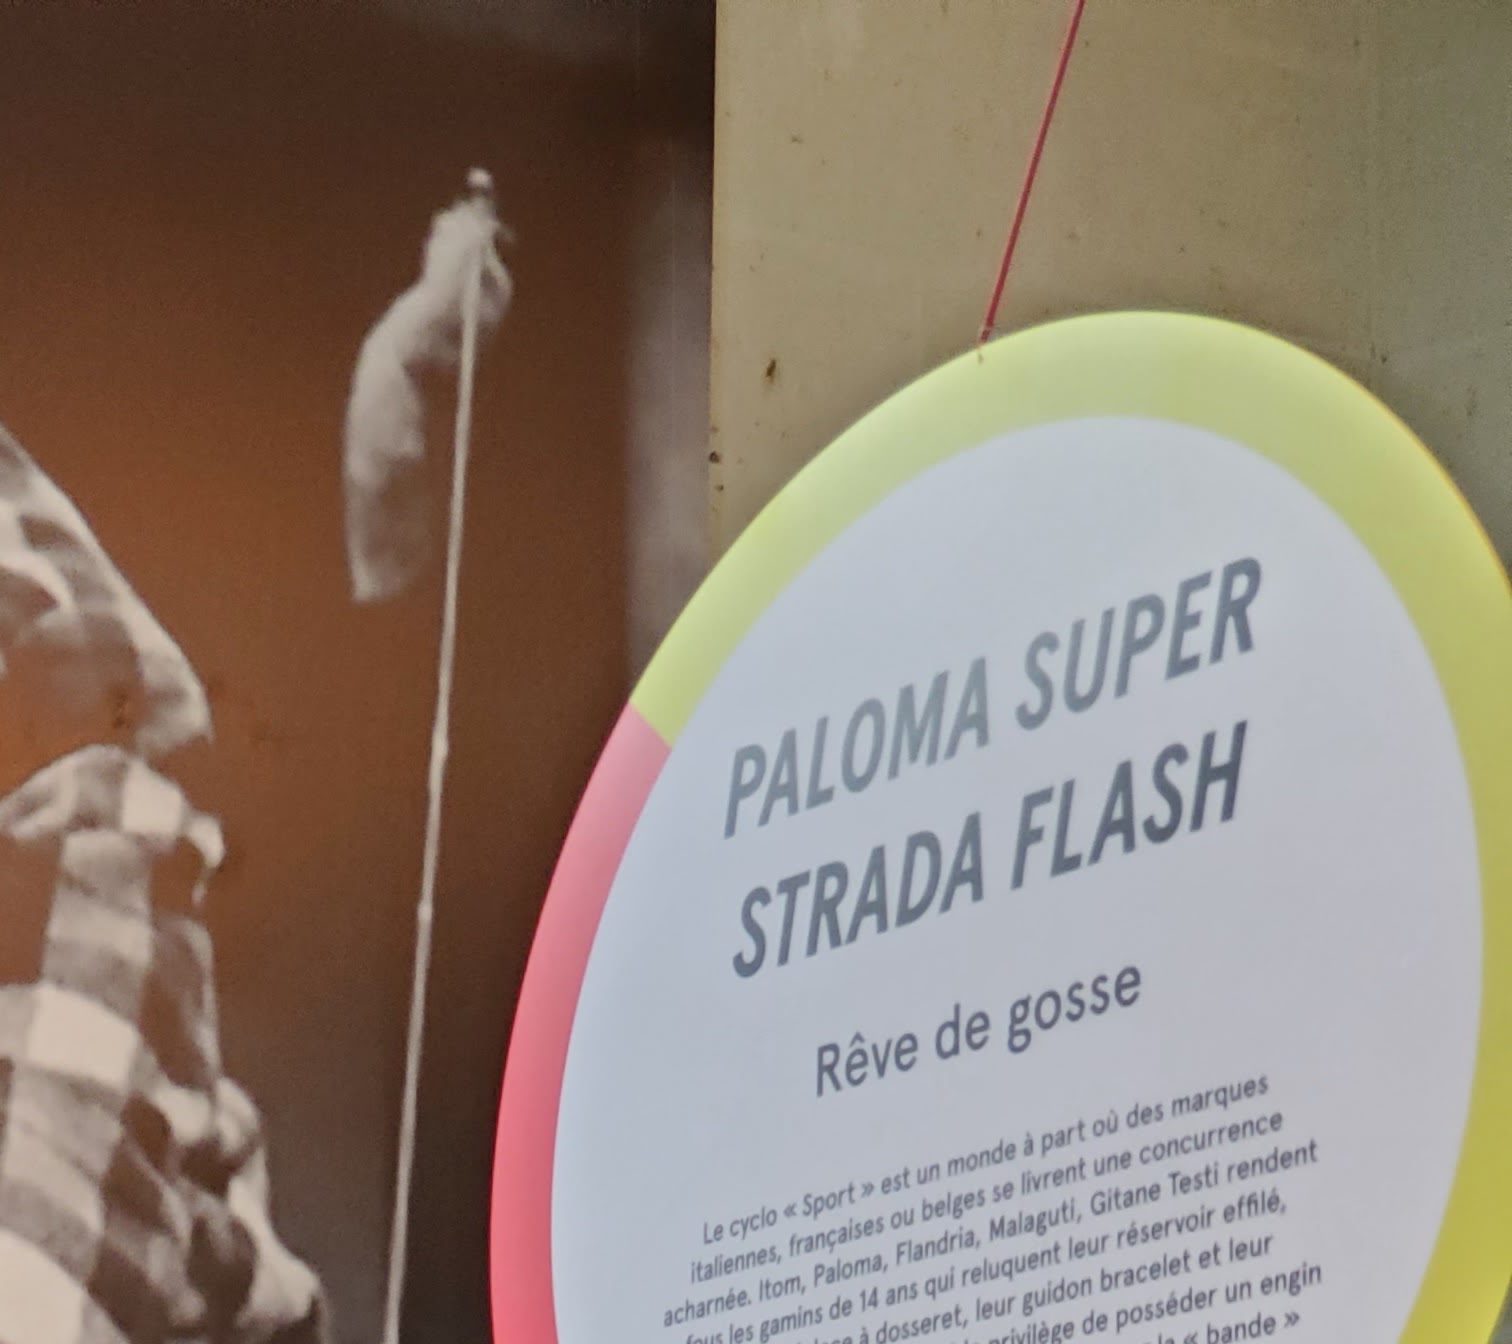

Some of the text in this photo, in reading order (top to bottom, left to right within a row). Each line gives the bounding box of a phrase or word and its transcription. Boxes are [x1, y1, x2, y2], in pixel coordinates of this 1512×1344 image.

[724, 556, 1263, 840] PALOMA SUPER
[732, 719, 1249, 979] STRADA FLASH
[816, 965, 1142, 1098] Rêve de gosse
[663, 1138, 1318, 1328] acharnée. Itom, Paloma, Flandria, Malaguti, Gitane Testi rendent
[691, 1112, 1284, 1284] italiennes, françaises ou belges se livrent une concurrence
[703, 1222, 724, 1245] Le
[729, 1206, 778, 1241] cyclo
[802, 1181, 856, 1221] Sport
[880, 1167, 911, 1196] est
[916, 1163, 941, 1186] un
[947, 1138, 1017, 1177] monde
[1023, 1132, 1035, 1157] à
[1041, 1119, 1086, 1158] part
[1092, 1109, 1119, 1138] où
[1125, 1102, 1165, 1129] des
[1171, 1075, 1269, 1118] marques
[759, 1305, 824, 1344] gamins
[828, 1295, 853, 1321] de
[859, 1286, 879, 1313] 14
[885, 1282, 919, 1307] ans
[924, 1265, 955, 1301] qui
[961, 1240, 1062, 1287] reluquent
[1068, 1233, 1110, 1261] leur
[1116, 1204, 1216, 1249] réservoir
[975, 1295, 1017, 1322] leur
[1021, 1276, 1093, 1318] guidon
[1099, 1248, 1191, 1293] bracelet
[1198, 1241, 1222, 1270] et
[1228, 1234, 1274, 1263] leur
[1081, 1308, 1109, 1336] de
[1115, 1286, 1218, 1335] posséder
[1224, 1280, 1253, 1305] un
[1259, 1261, 1322, 1297] engin
